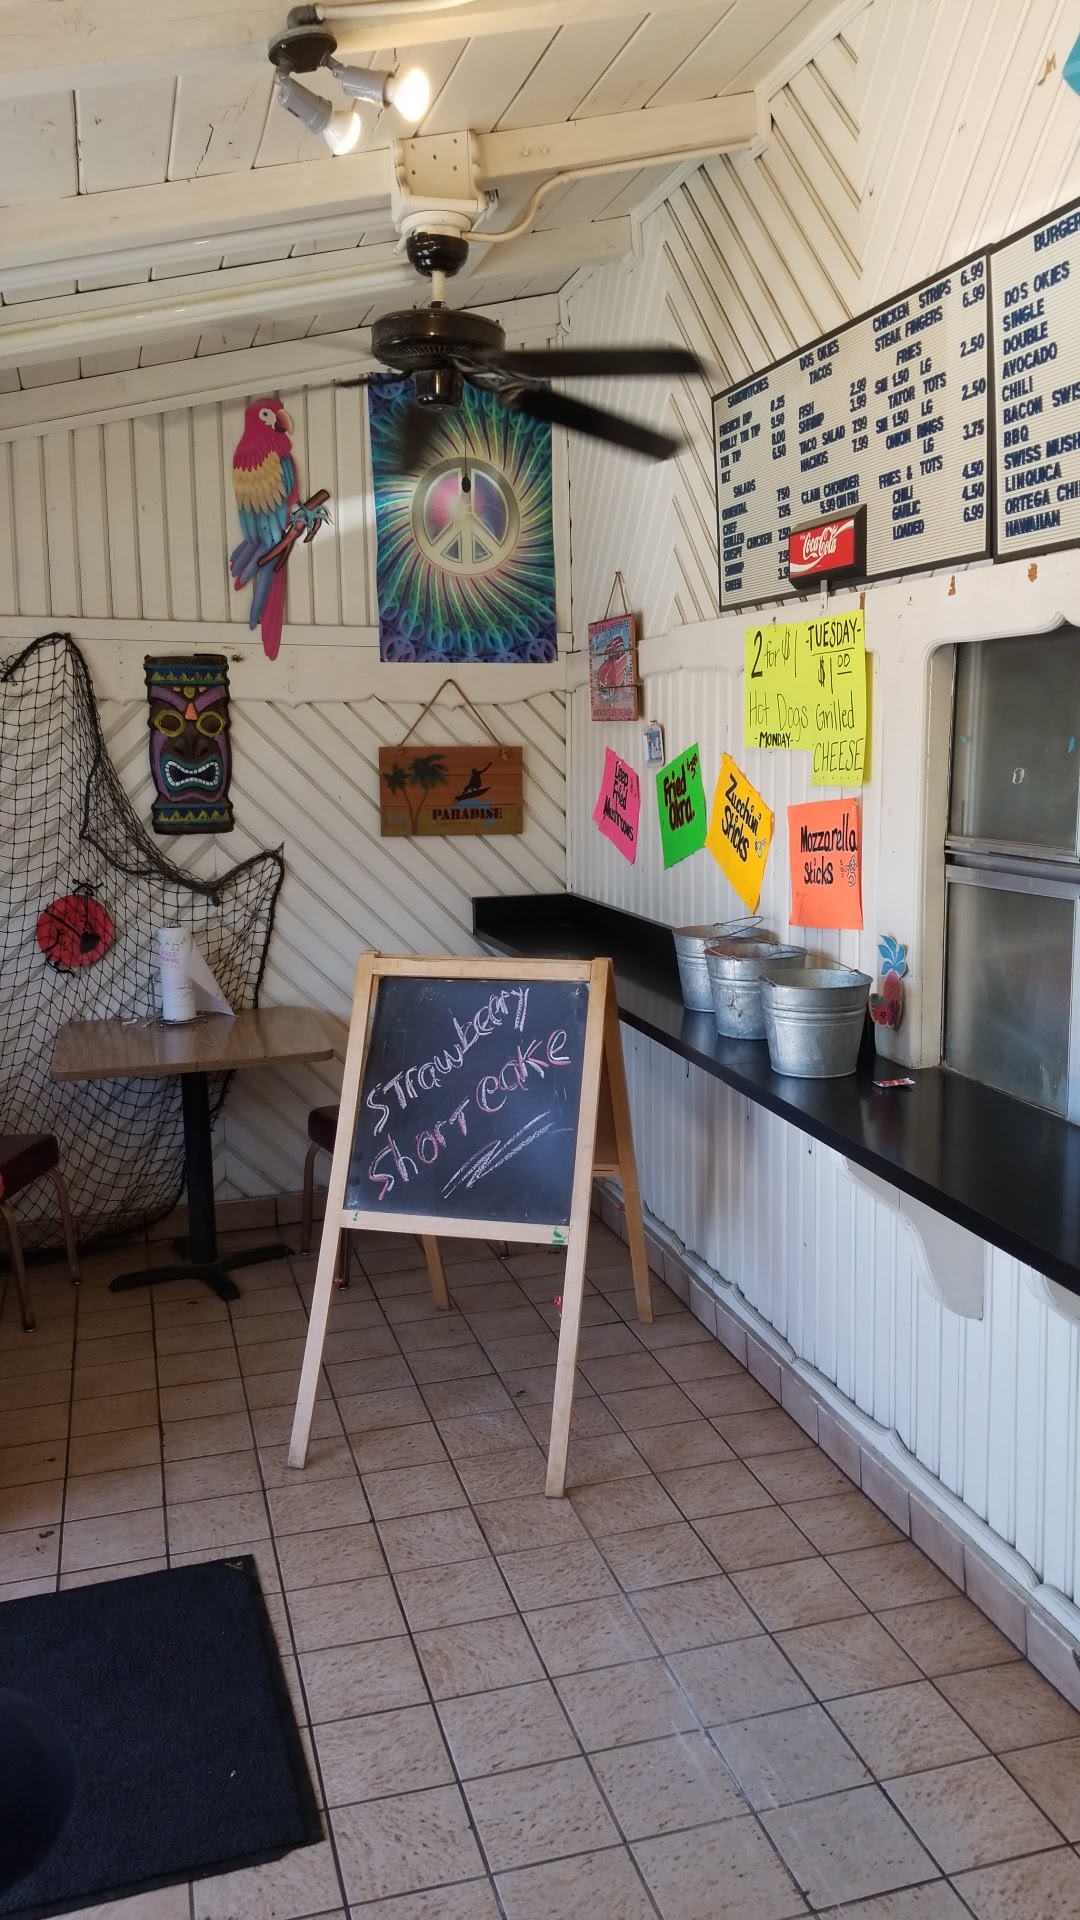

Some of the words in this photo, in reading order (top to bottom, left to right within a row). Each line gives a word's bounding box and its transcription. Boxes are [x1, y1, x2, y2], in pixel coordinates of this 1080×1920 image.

[873, 301, 910, 332] CHICKEN
[918, 279, 951, 309] STRIPS
[960, 261, 984, 287] 6.99
[1004, 281, 1028, 308] DOS
[1034, 260, 1070, 292] OKIES
[875, 326, 902, 352] STEAK
[905, 305, 943, 338] FINGERS
[962, 283, 985, 308] 6.99
[1002, 298, 1045, 332] SINGLE
[799, 352, 814, 371] DOS
[817, 339, 840, 361] OKIES
[896, 341, 922, 366] FRIES
[1003, 320, 1049, 355] DOUBLE
[809, 362, 832, 385] TACOS
[875, 376, 888, 395] SM
[920, 357, 932, 375] LG
[960, 332, 984, 358] 2.50
[1002, 342, 1057, 379] AVOCADO
[799, 401, 815, 420] FISH
[850, 377, 866, 397] 2.99
[875, 416, 888, 434] SM
[921, 399, 933, 417] LG
[961, 377, 986, 401] 2.50
[888, 385, 915, 409] TATOR
[923, 371, 947, 395] TOTS
[1002, 375, 1033, 402] CHILI
[719, 416, 741, 437] FRENCH
[742, 410, 753, 426] DIP
[799, 411, 824, 434] SHRIMP
[1003, 395, 1044, 425] BACON
[750, 423, 761, 438] TIP
[799, 437, 817, 455] TACO
[822, 425, 845, 446] SALAD
[886, 428, 911, 450] ONION
[917, 415, 944, 439] RINGS
[923, 436, 935, 454] LG
[962, 418, 984, 441] 3.75
[1003, 425, 1029, 448] BBQ
[800, 450, 828, 473] NACHOS
[878, 469, 901, 490] FRIES
[919, 454, 943, 476] TOTS
[1003, 444, 1042, 470] SWISS
[733, 479, 756, 498] SALADS
[801, 487, 820, 505] CLAM
[823, 474, 860, 497] CHOWDER
[892, 485, 913, 505] CHILI
[962, 459, 984, 479] 4.50
[836, 493, 847, 509] ON
[892, 499, 921, 521] GARLIC
[962, 481, 984, 501] 4.50
[1004, 488, 1051, 515] ORTEGA
[893, 519, 924, 540] LOADED
[963, 503, 984, 522] 6.99
[1005, 509, 1061, 537] HAWAIIAN
[747, 531, 773, 549] CHICKEN
[802, 525, 839, 560] Coca-Cola
[751, 630, 763, 679] 2
[763, 640, 780, 668] for
[748, 690, 770, 727] Hot
[776, 693, 809, 742] Dogs
[815, 690, 855, 731] Grilled
[813, 737, 864, 772] CHEESE
[614, 760, 629, 791] Deep
[663, 763, 687, 807] Fried
[612, 779, 629, 812] Fried
[725, 773, 762, 837] Zucchini
[432, 807, 503, 820] PARADISE
[721, 805, 750, 862] Sticks
[800, 812, 858, 853] Mozzarella
